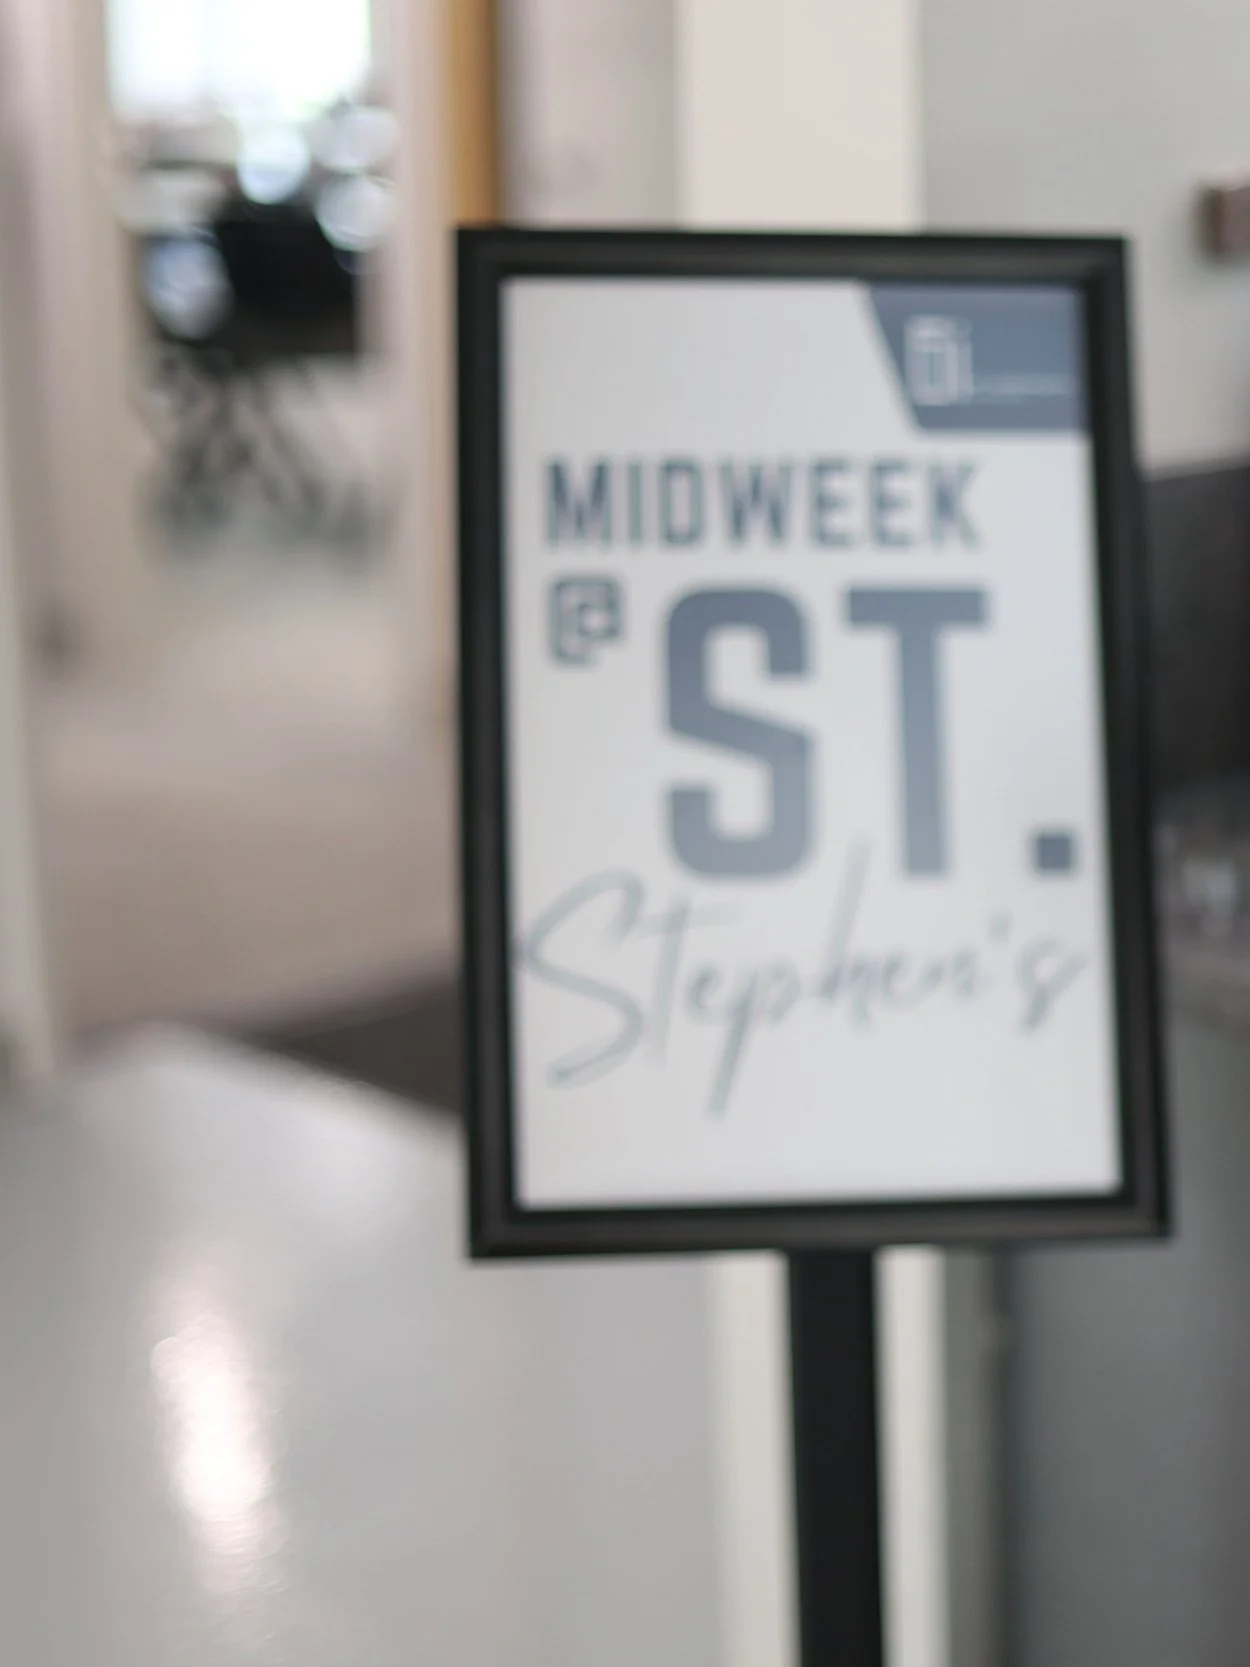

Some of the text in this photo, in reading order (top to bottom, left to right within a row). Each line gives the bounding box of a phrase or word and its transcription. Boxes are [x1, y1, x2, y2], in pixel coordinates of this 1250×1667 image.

[544, 458, 982, 550] MIDWEEK
[548, 575, 1076, 879] @ ST.
[517, 838, 1086, 1118] Stephen's
